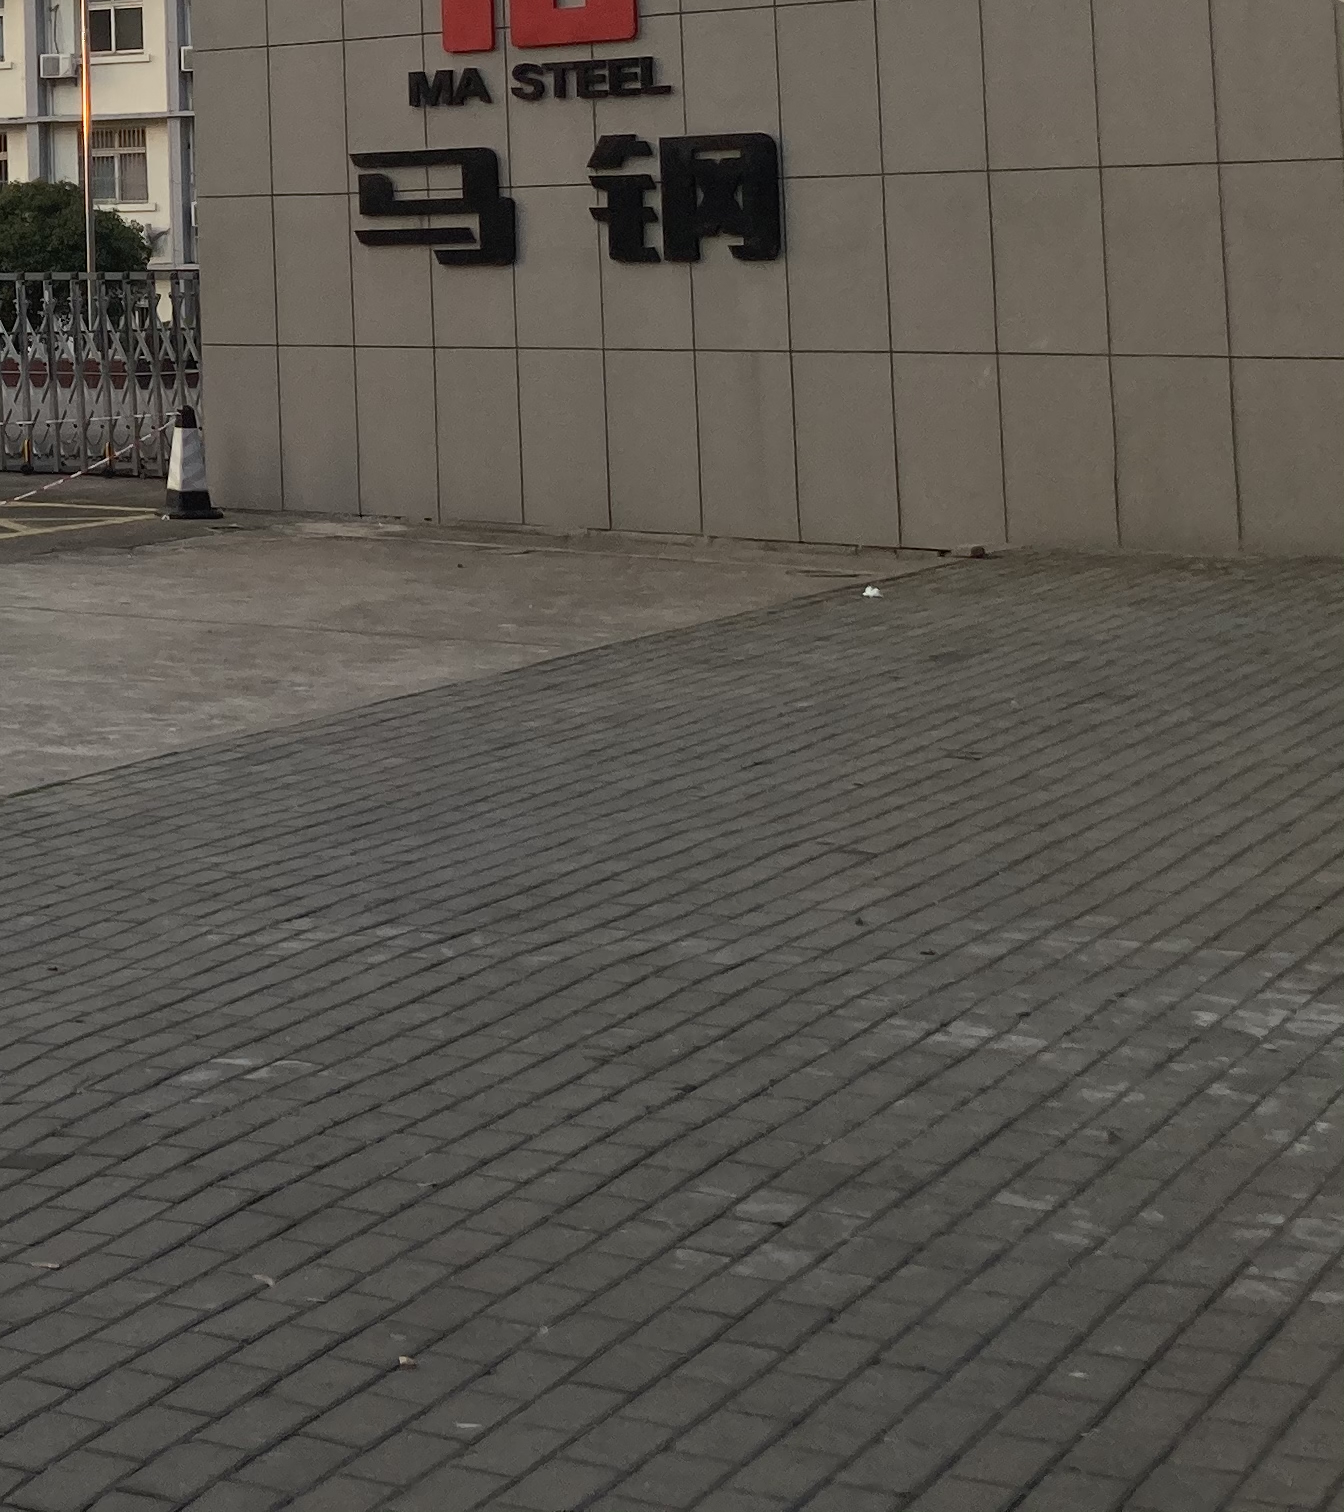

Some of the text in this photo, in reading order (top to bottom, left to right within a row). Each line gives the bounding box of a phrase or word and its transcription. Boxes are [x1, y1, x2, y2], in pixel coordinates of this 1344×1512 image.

[408, 55, 672, 108] MA STEEL
[349, 132, 782, 266] 马钢
